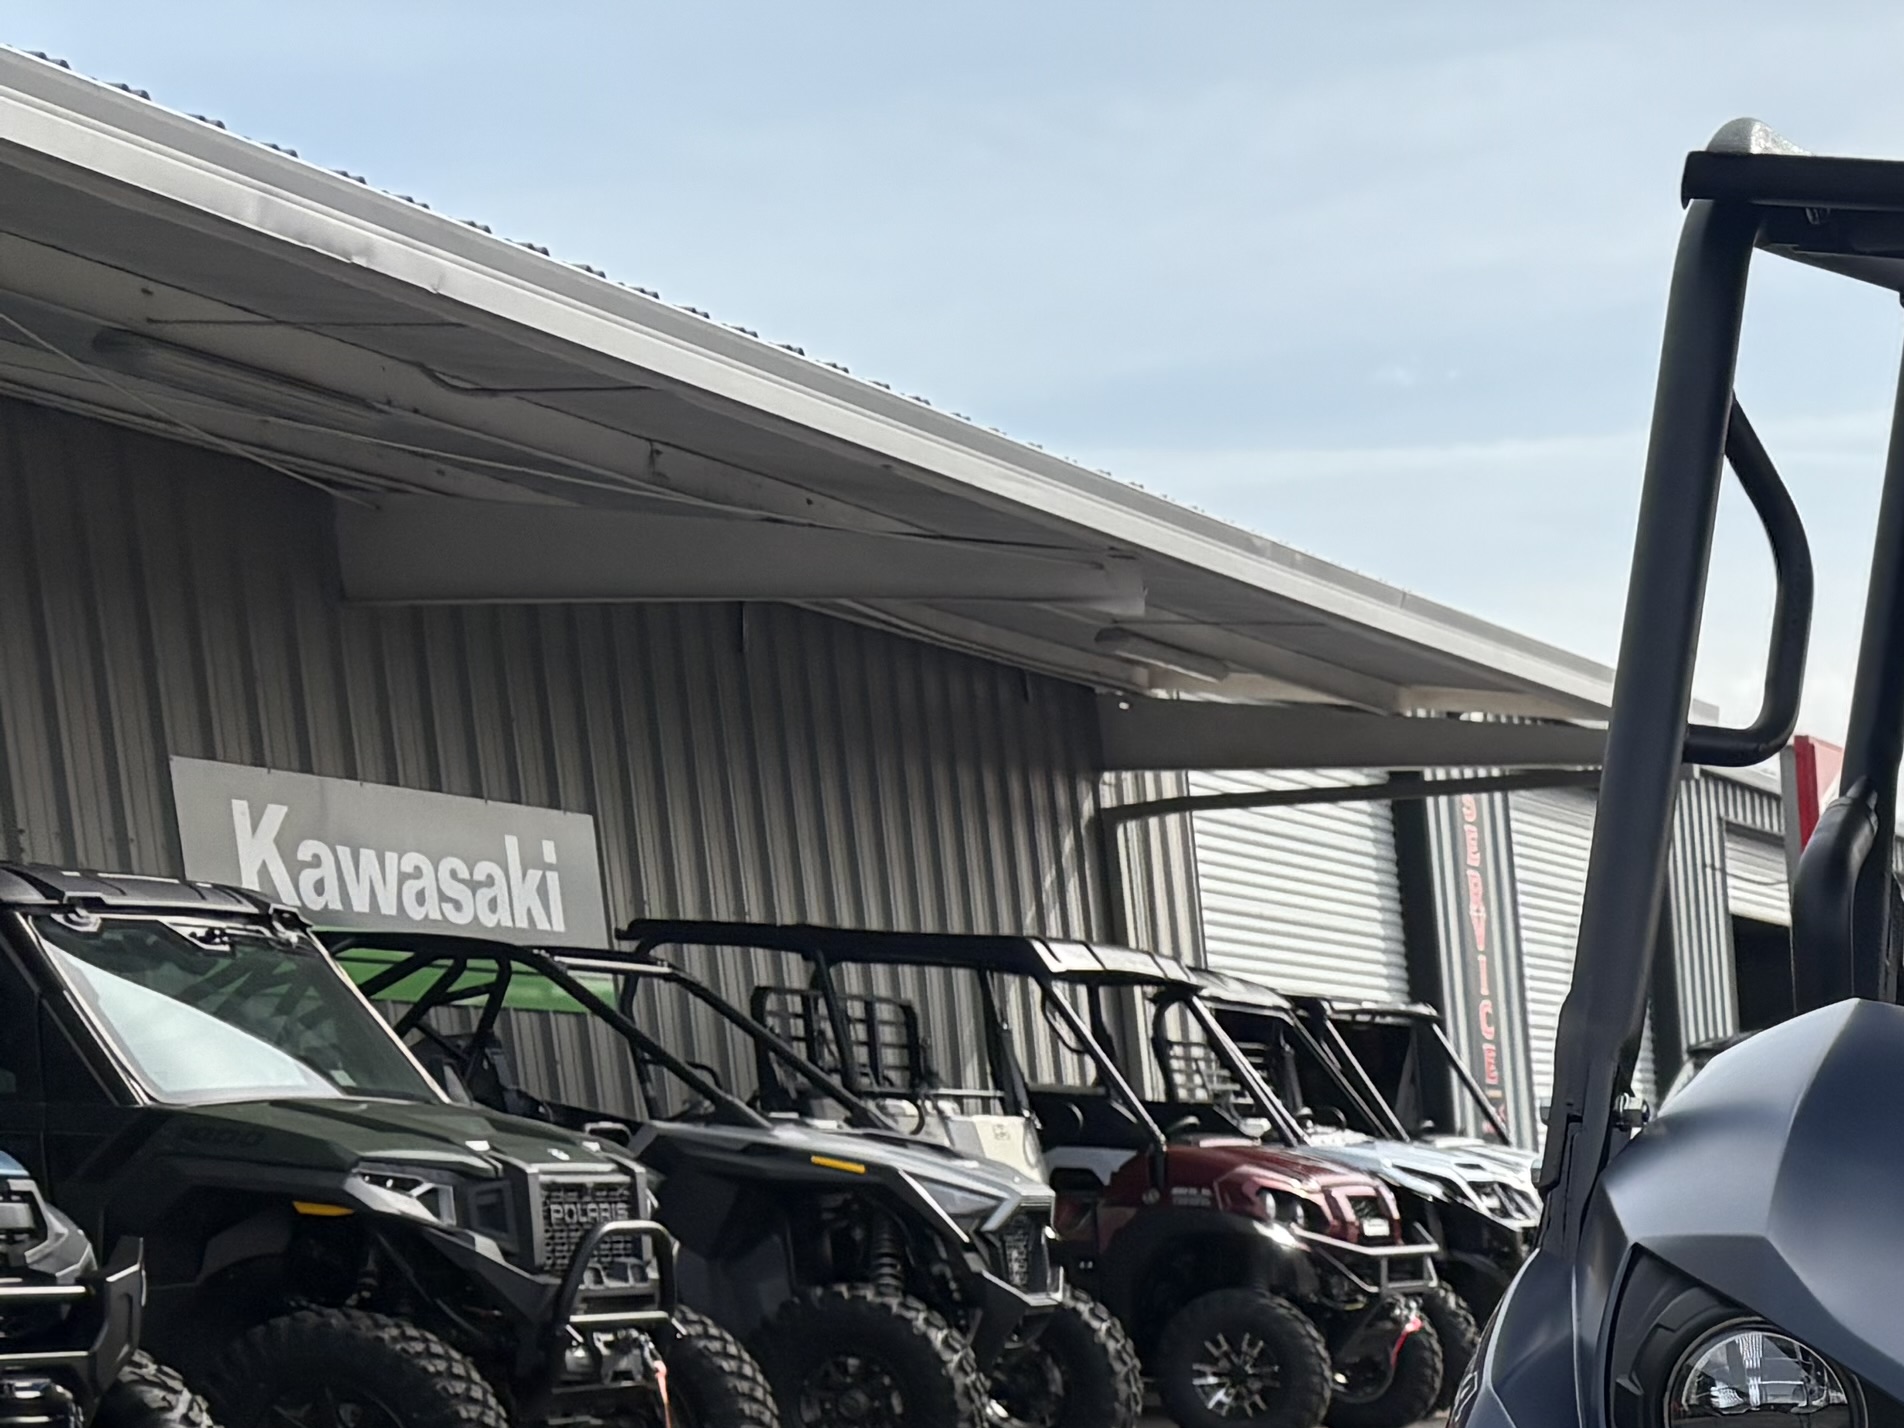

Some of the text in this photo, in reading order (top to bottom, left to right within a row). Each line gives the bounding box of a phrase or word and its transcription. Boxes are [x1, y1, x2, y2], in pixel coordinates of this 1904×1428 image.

[231, 798, 566, 933] Kawasaki
[1461, 793, 1499, 1085] SERVICE
[549, 1202, 630, 1224] POLARIS
